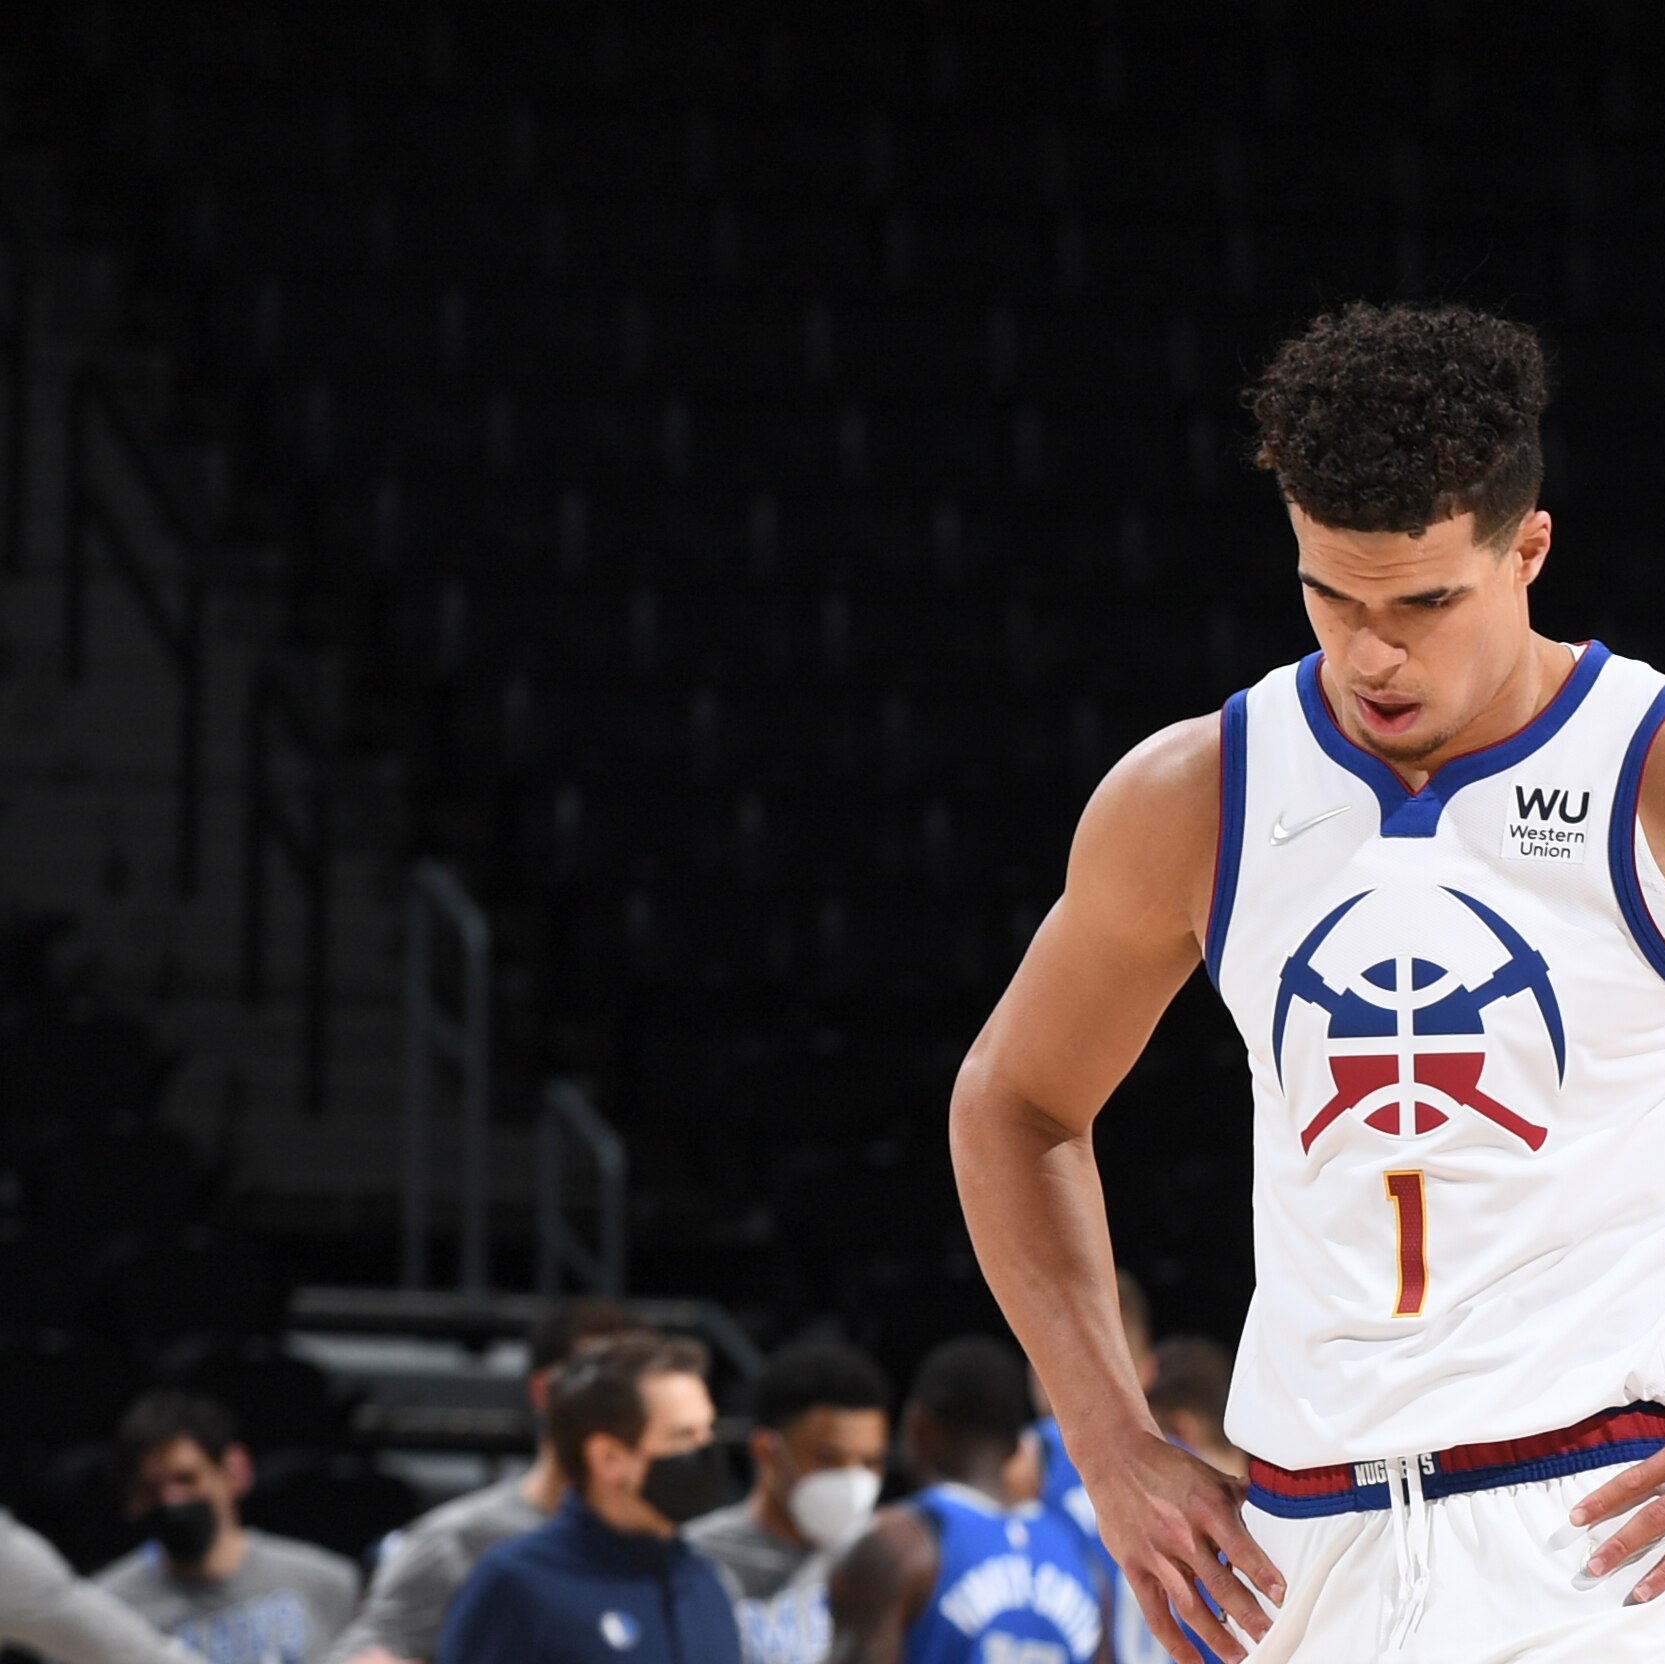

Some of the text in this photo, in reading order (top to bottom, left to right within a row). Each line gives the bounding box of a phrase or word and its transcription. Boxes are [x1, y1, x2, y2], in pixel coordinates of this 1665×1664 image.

[1515, 785, 1590, 824] WU
[1509, 824, 1585, 844] Western
[1520, 841, 1571, 859] Union
[1382, 1169, 1430, 1318] 1
